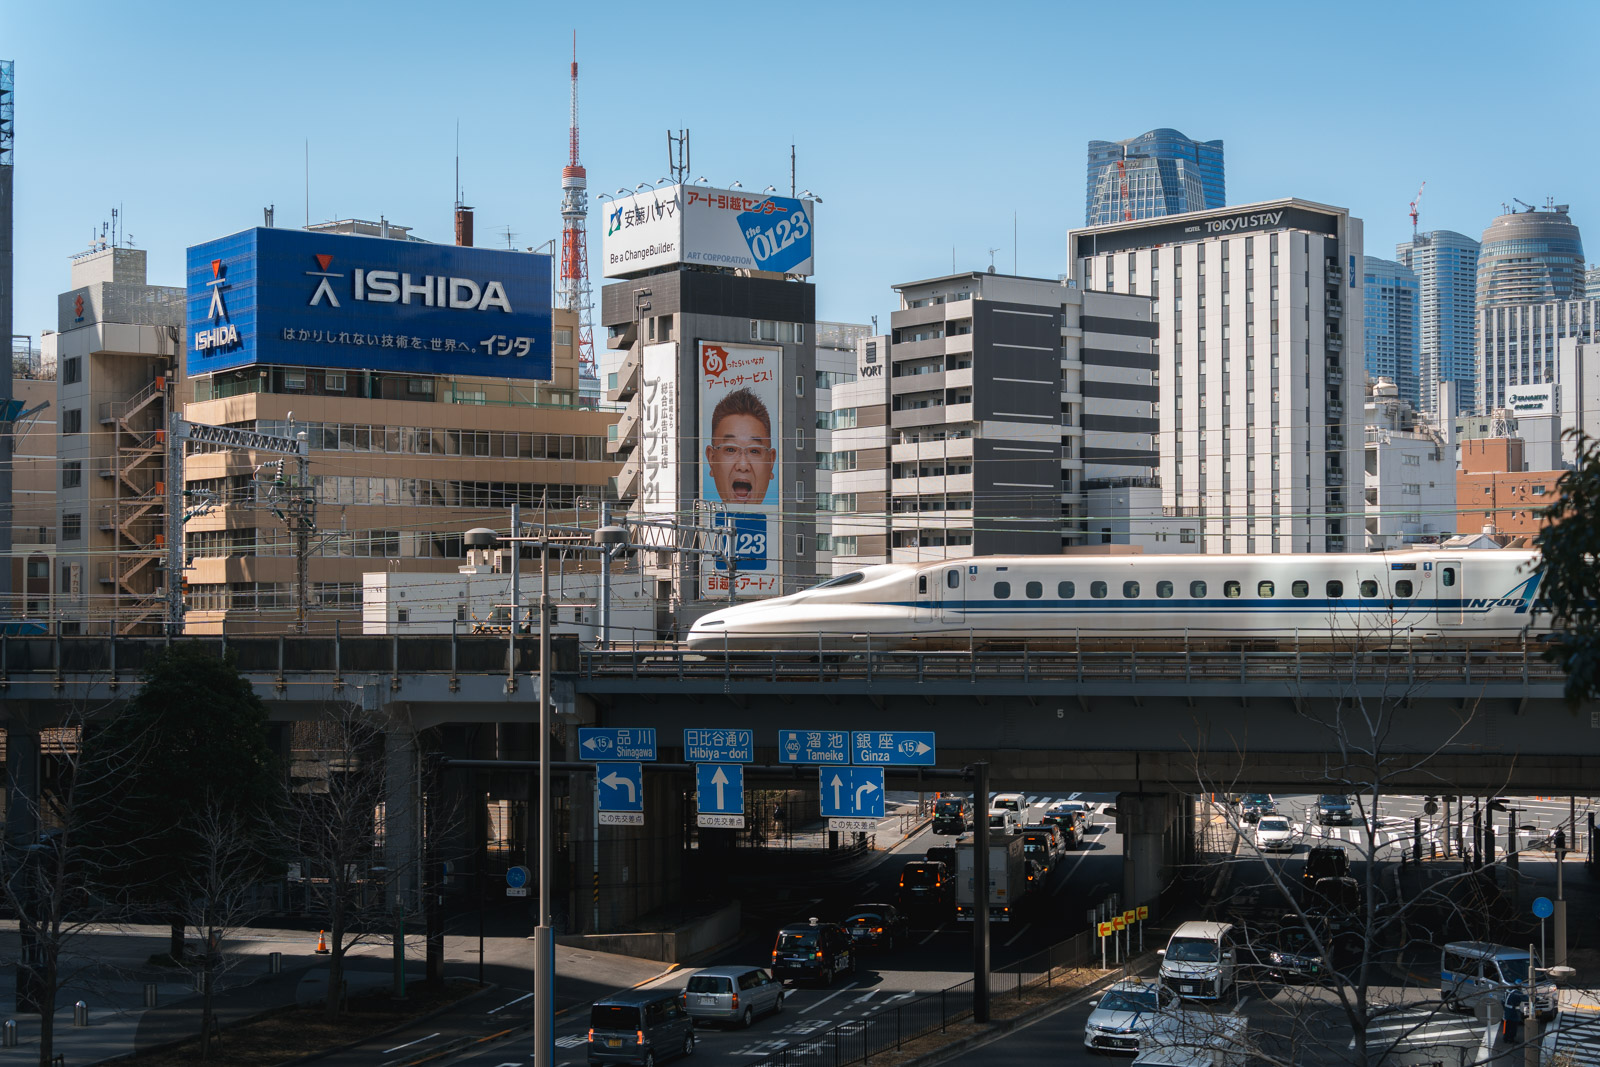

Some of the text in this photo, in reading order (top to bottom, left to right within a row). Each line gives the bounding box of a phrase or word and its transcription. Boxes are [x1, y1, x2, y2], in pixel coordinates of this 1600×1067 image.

[688, 192, 788, 214] アート引越センター
[624, 200, 676, 228] 安藤ハザマ
[1184, 210, 1284, 234] HOTEL TOKYU STAY
[745, 224, 761, 239] the
[752, 211, 810, 262] 0123
[610, 254, 619, 264] Be
[686, 252, 752, 264] ART CORPORATION
[354, 268, 514, 313] ISHIDA
[195, 324, 238, 351] ISHIDA
[283, 328, 535, 357] はかりしれない技術を、世界へ。 イシダ
[860, 364, 882, 377] VORT
[706, 370, 773, 390] アートのサービス!
[1056, 708, 1064, 718] 5
[597, 738, 607, 748] 15
[617, 730, 652, 745] 品川
[687, 730, 750, 746] 日比谷通り
[806, 732, 843, 748] 溜池
[856, 733, 894, 749] 銀座
[616, 746, 652, 759] Shinagawa
[904, 742, 914, 752] 15
[806, 749, 844, 761] Tameike
[861, 750, 890, 762] Ginza
[600, 815, 642, 824] この先交差点
[700, 817, 742, 826] この先交差点
[831, 820, 876, 830] この先交差点
